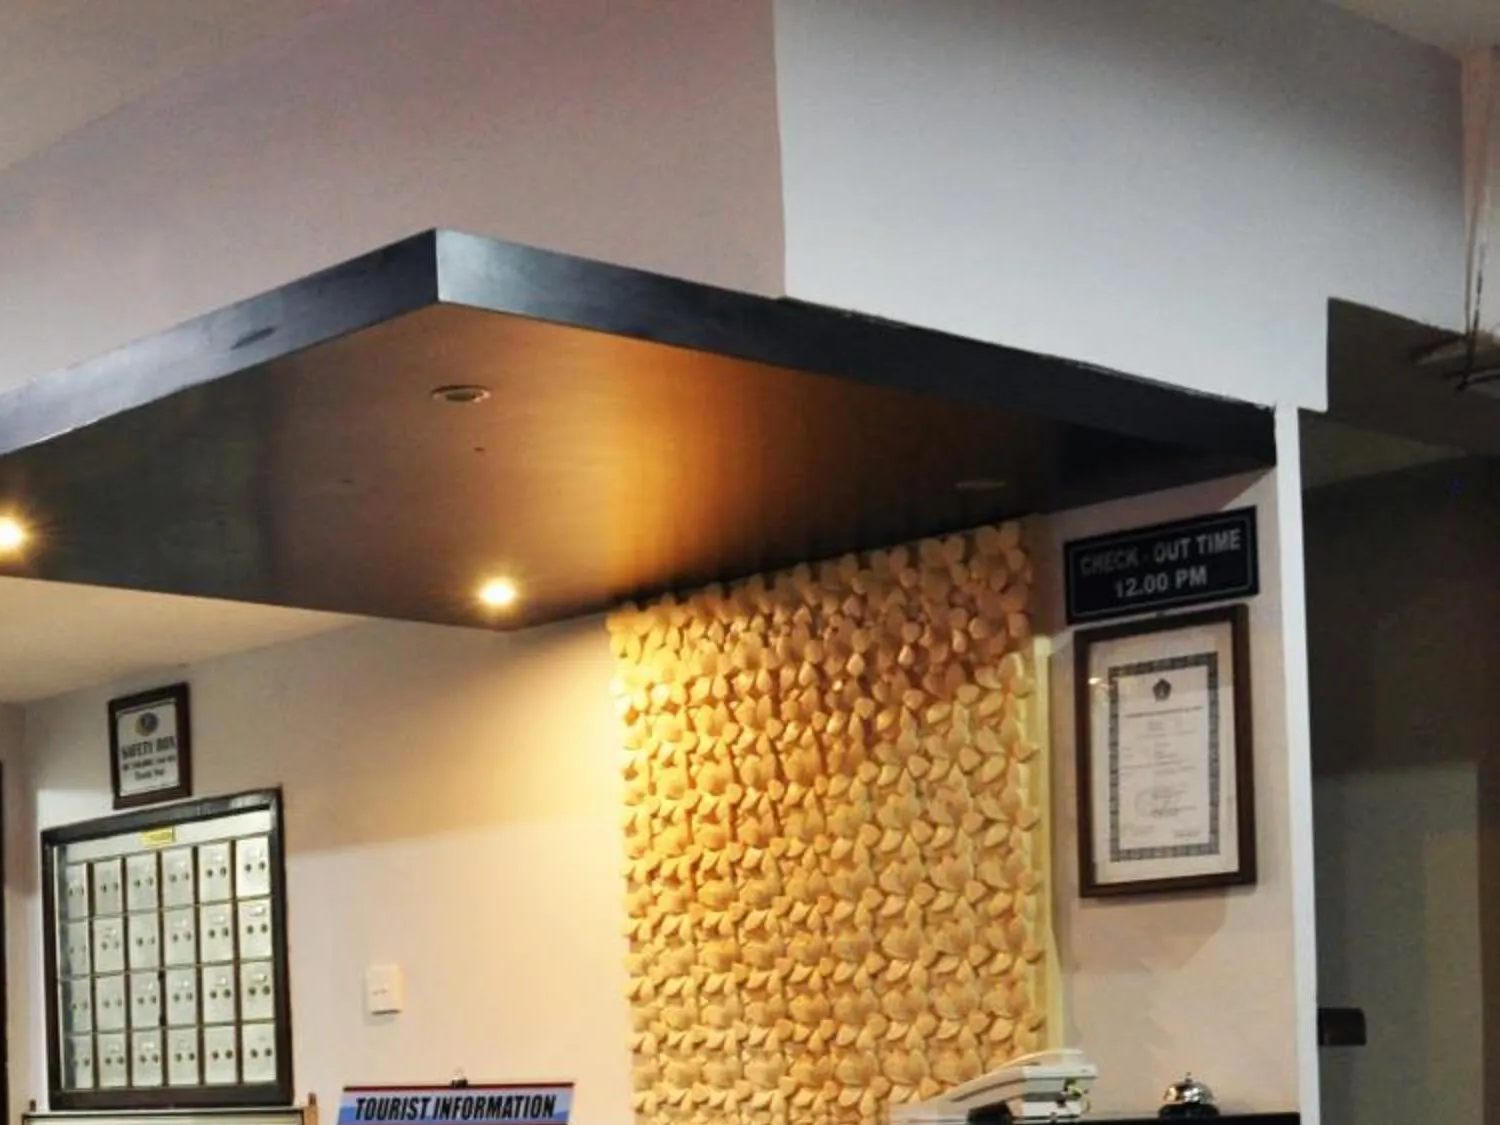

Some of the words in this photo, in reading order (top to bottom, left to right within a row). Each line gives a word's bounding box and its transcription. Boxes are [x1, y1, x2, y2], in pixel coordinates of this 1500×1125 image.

[1079, 546, 1139, 576] CHECK
[1153, 537, 1191, 563] OUT
[1195, 528, 1243, 555] TIME
[1115, 572, 1169, 598] 12.00
[1174, 564, 1208, 589] PM
[354, 1097, 432, 1121] TOURIST
[431, 1094, 558, 1119] INFORMATION
